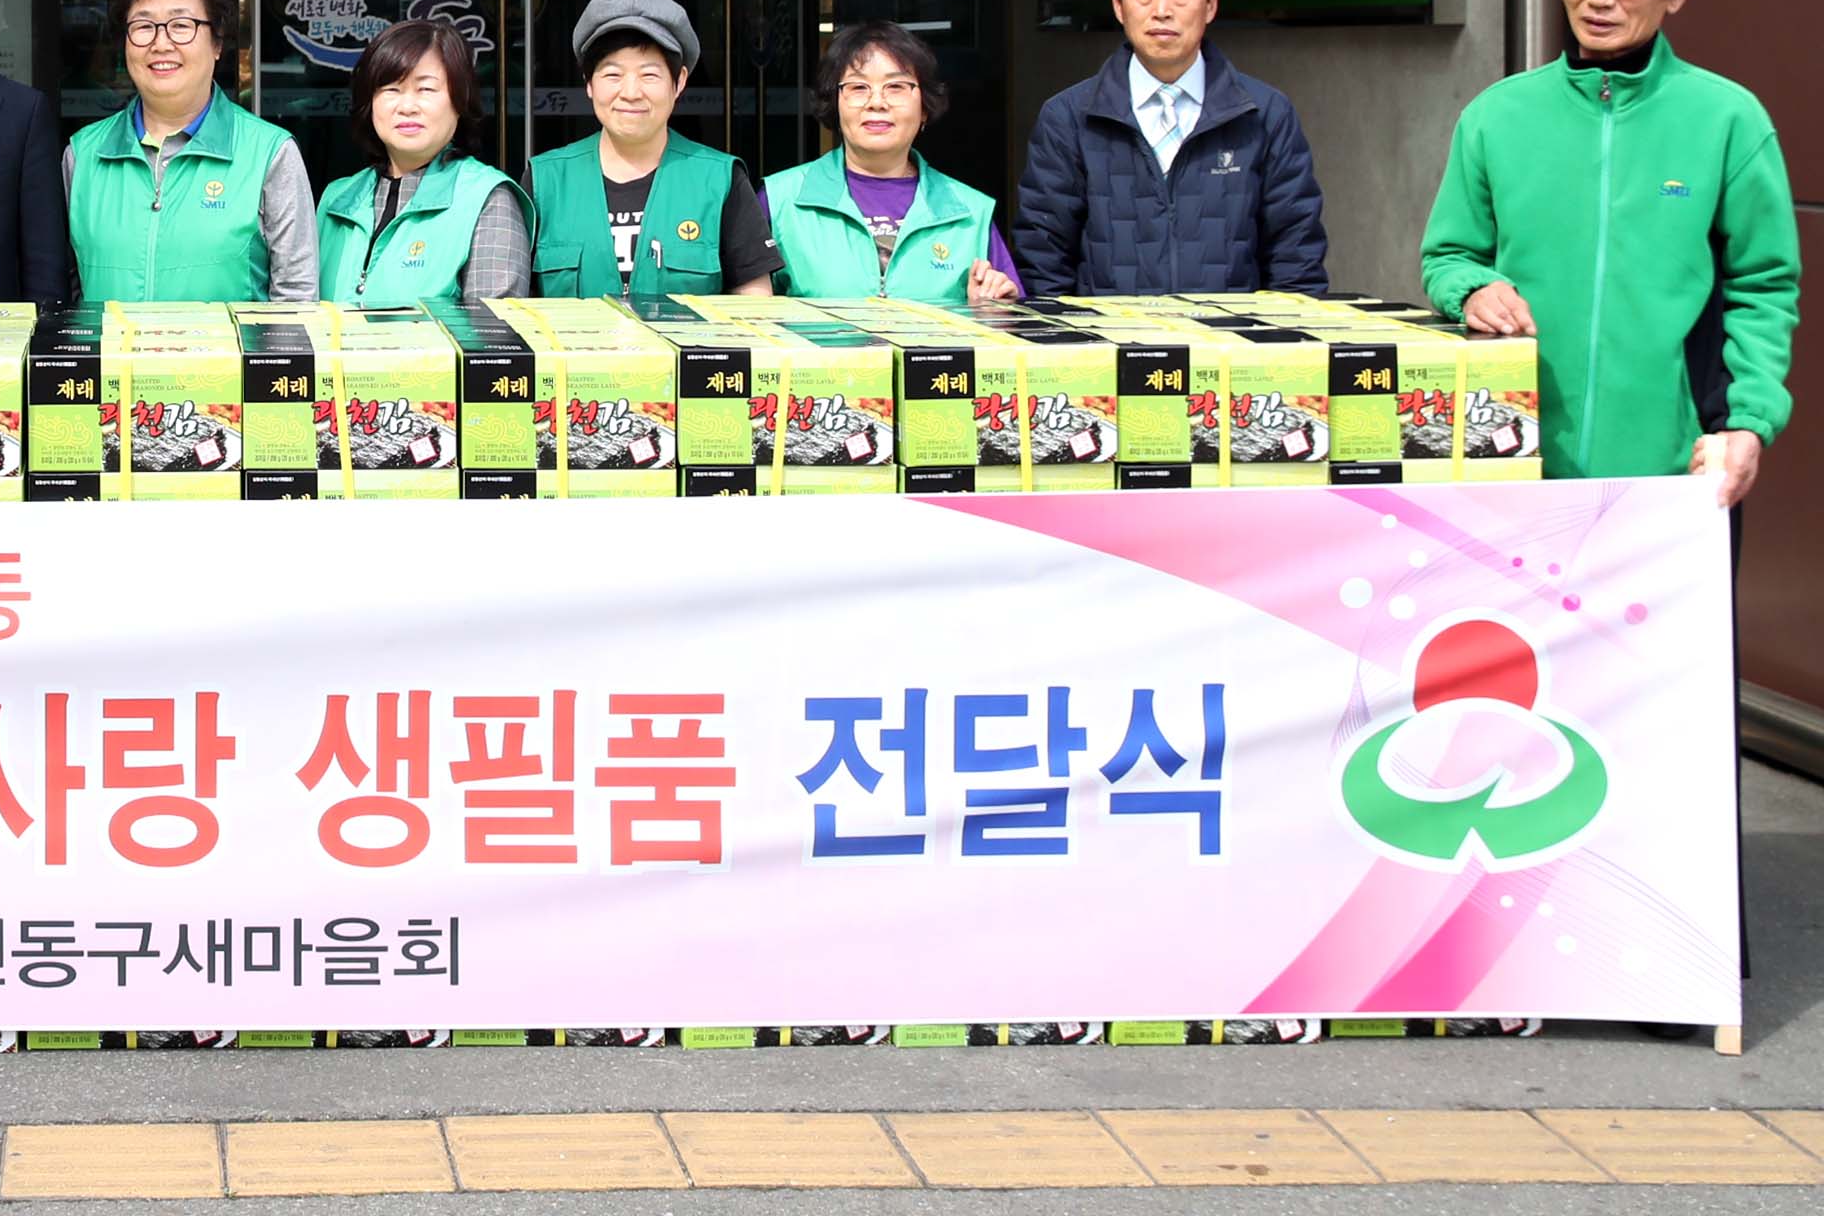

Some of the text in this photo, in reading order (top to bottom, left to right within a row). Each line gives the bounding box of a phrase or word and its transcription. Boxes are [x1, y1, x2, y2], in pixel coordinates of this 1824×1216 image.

[705, 371, 744, 394] 재래
[930, 372, 968, 395] 재래
[981, 372, 1006, 386] 백제
[1145, 369, 1183, 392] 재래
[1353, 367, 1392, 391] 재래
[1404, 368, 1428, 381] 백제
[56, 378, 94, 401] 재래
[270, 376, 308, 398] 재래
[490, 376, 528, 398] 재래
[298, 689, 734, 867] 생필품
[798, 685, 1227, 857] 전달식
